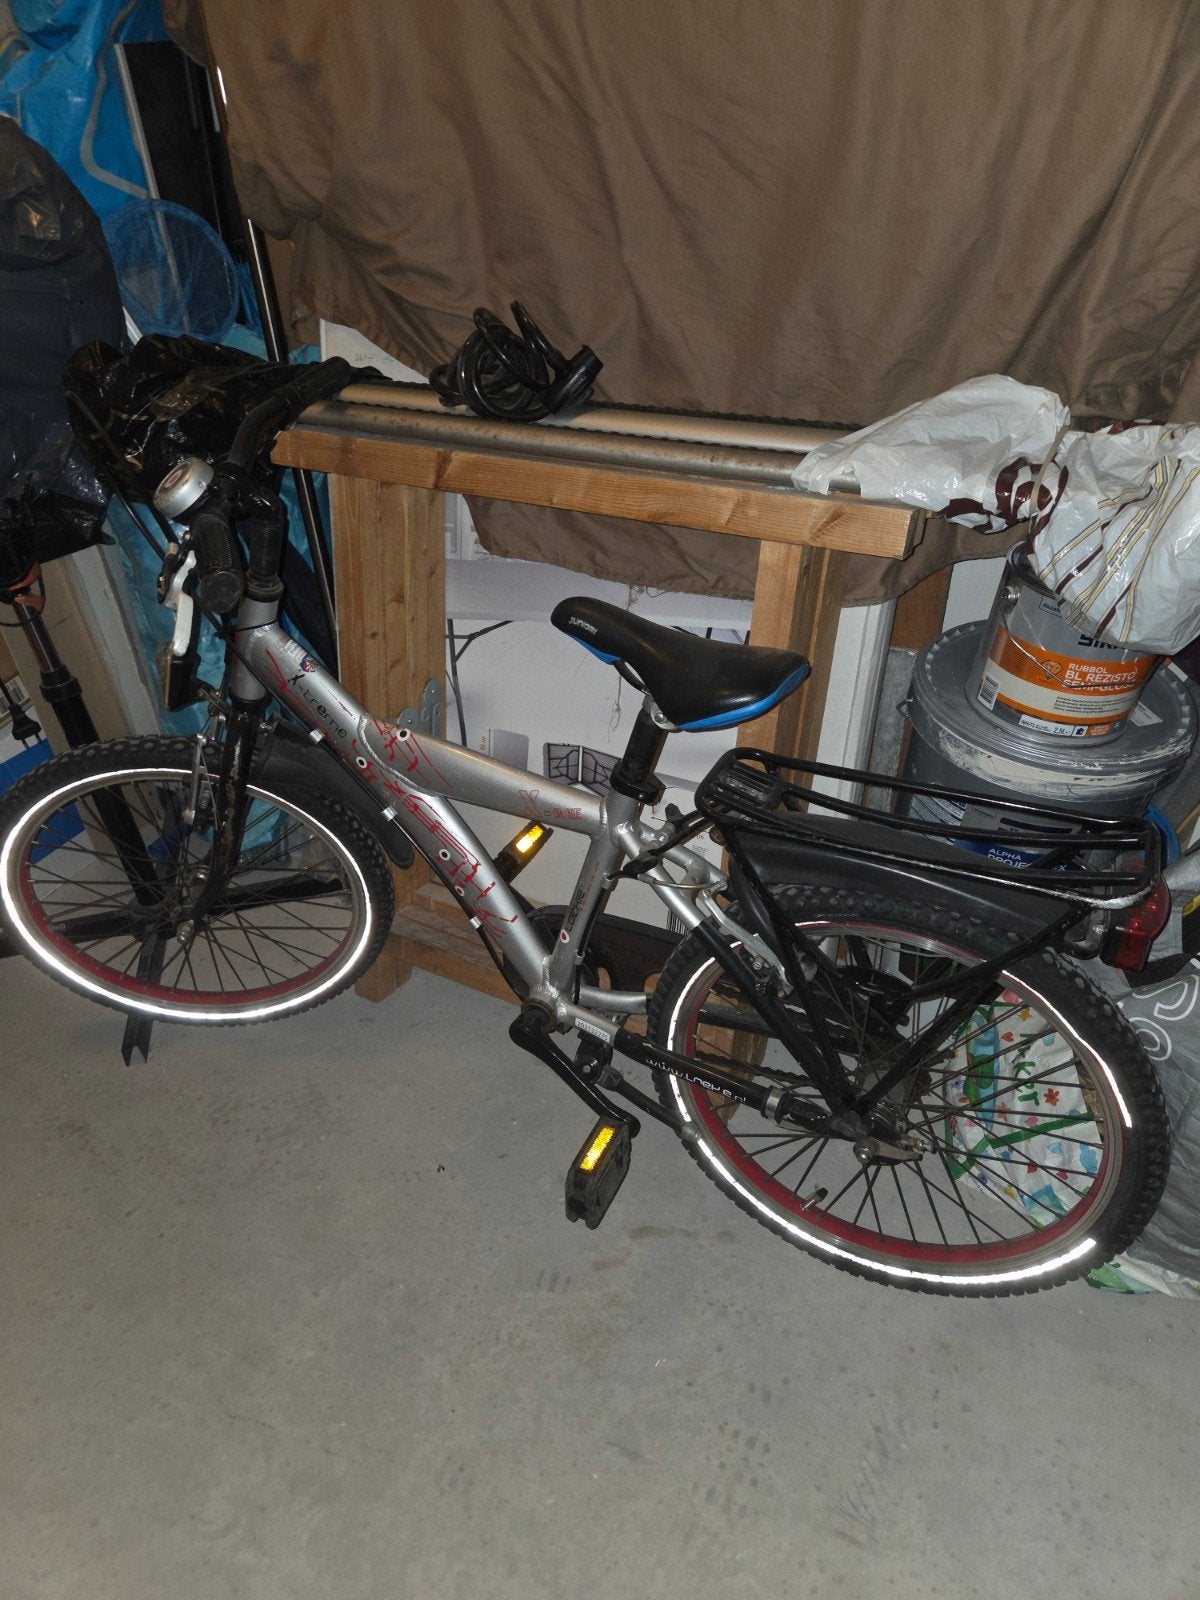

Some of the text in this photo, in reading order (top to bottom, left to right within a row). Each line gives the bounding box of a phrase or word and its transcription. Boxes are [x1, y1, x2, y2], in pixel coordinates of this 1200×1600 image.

[1069, 663, 1108, 674] RUBBOL
[1065, 670, 1082, 681] BL
[988, 848, 1021, 861] ALPHA
